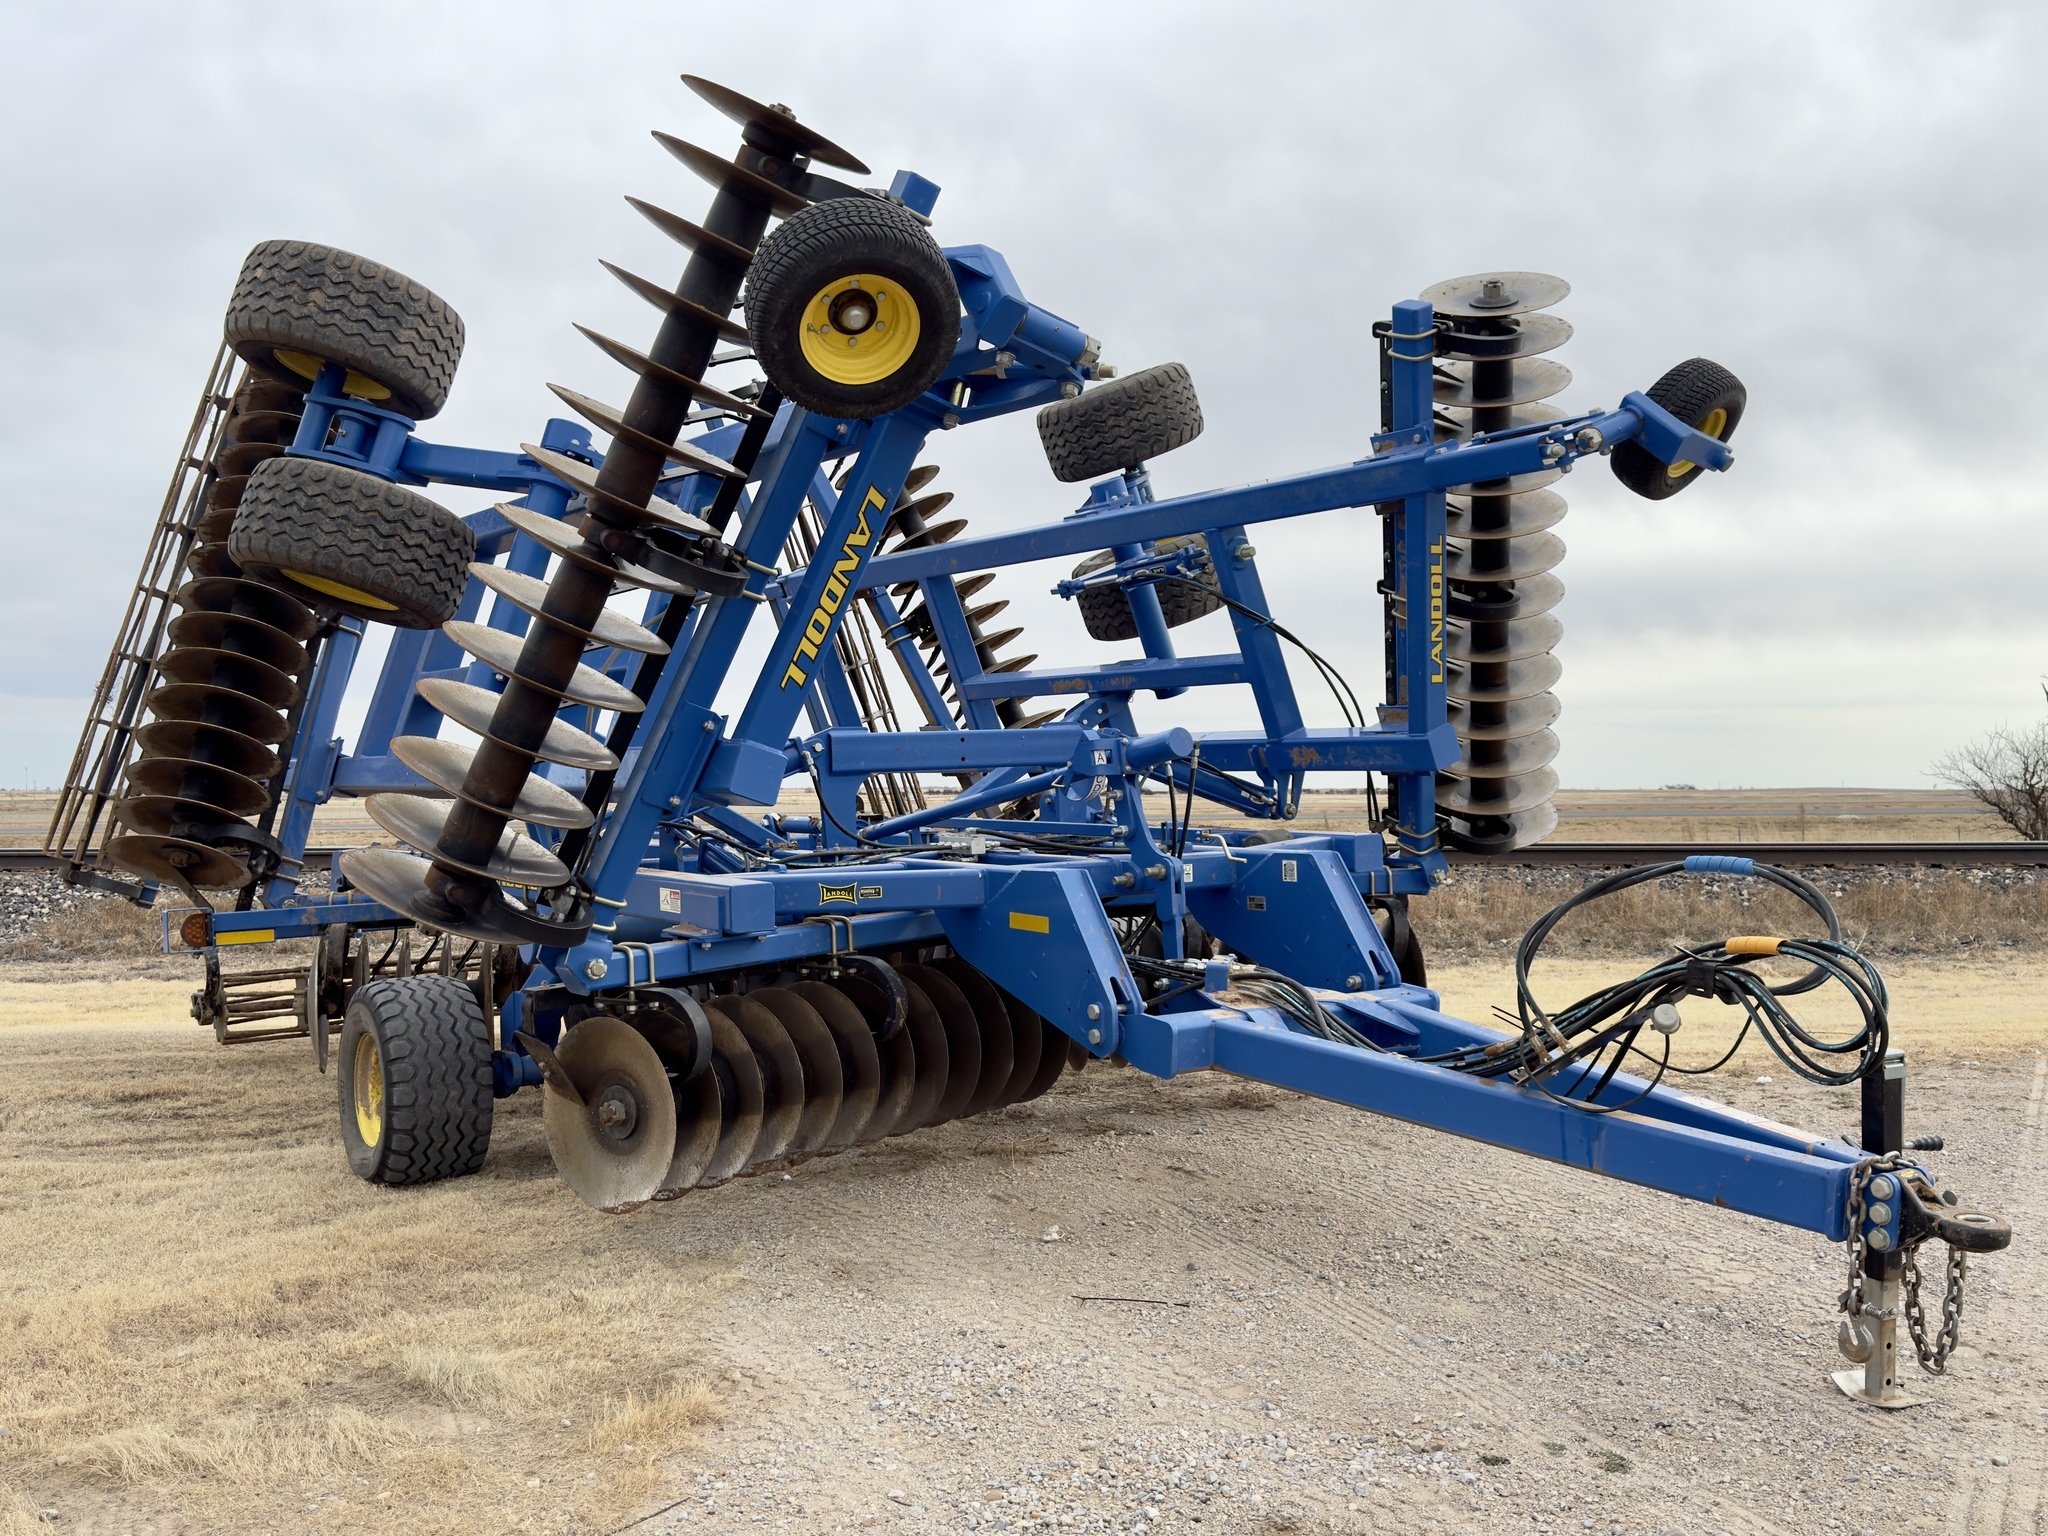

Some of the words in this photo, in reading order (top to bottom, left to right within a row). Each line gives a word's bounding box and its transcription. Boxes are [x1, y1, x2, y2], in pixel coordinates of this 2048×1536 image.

[780, 483, 888, 690] LANDOLL
[1430, 534, 1443, 684] LANDOLL
[1097, 752, 1105, 763] A
[823, 887, 853, 900] LANDOLL
